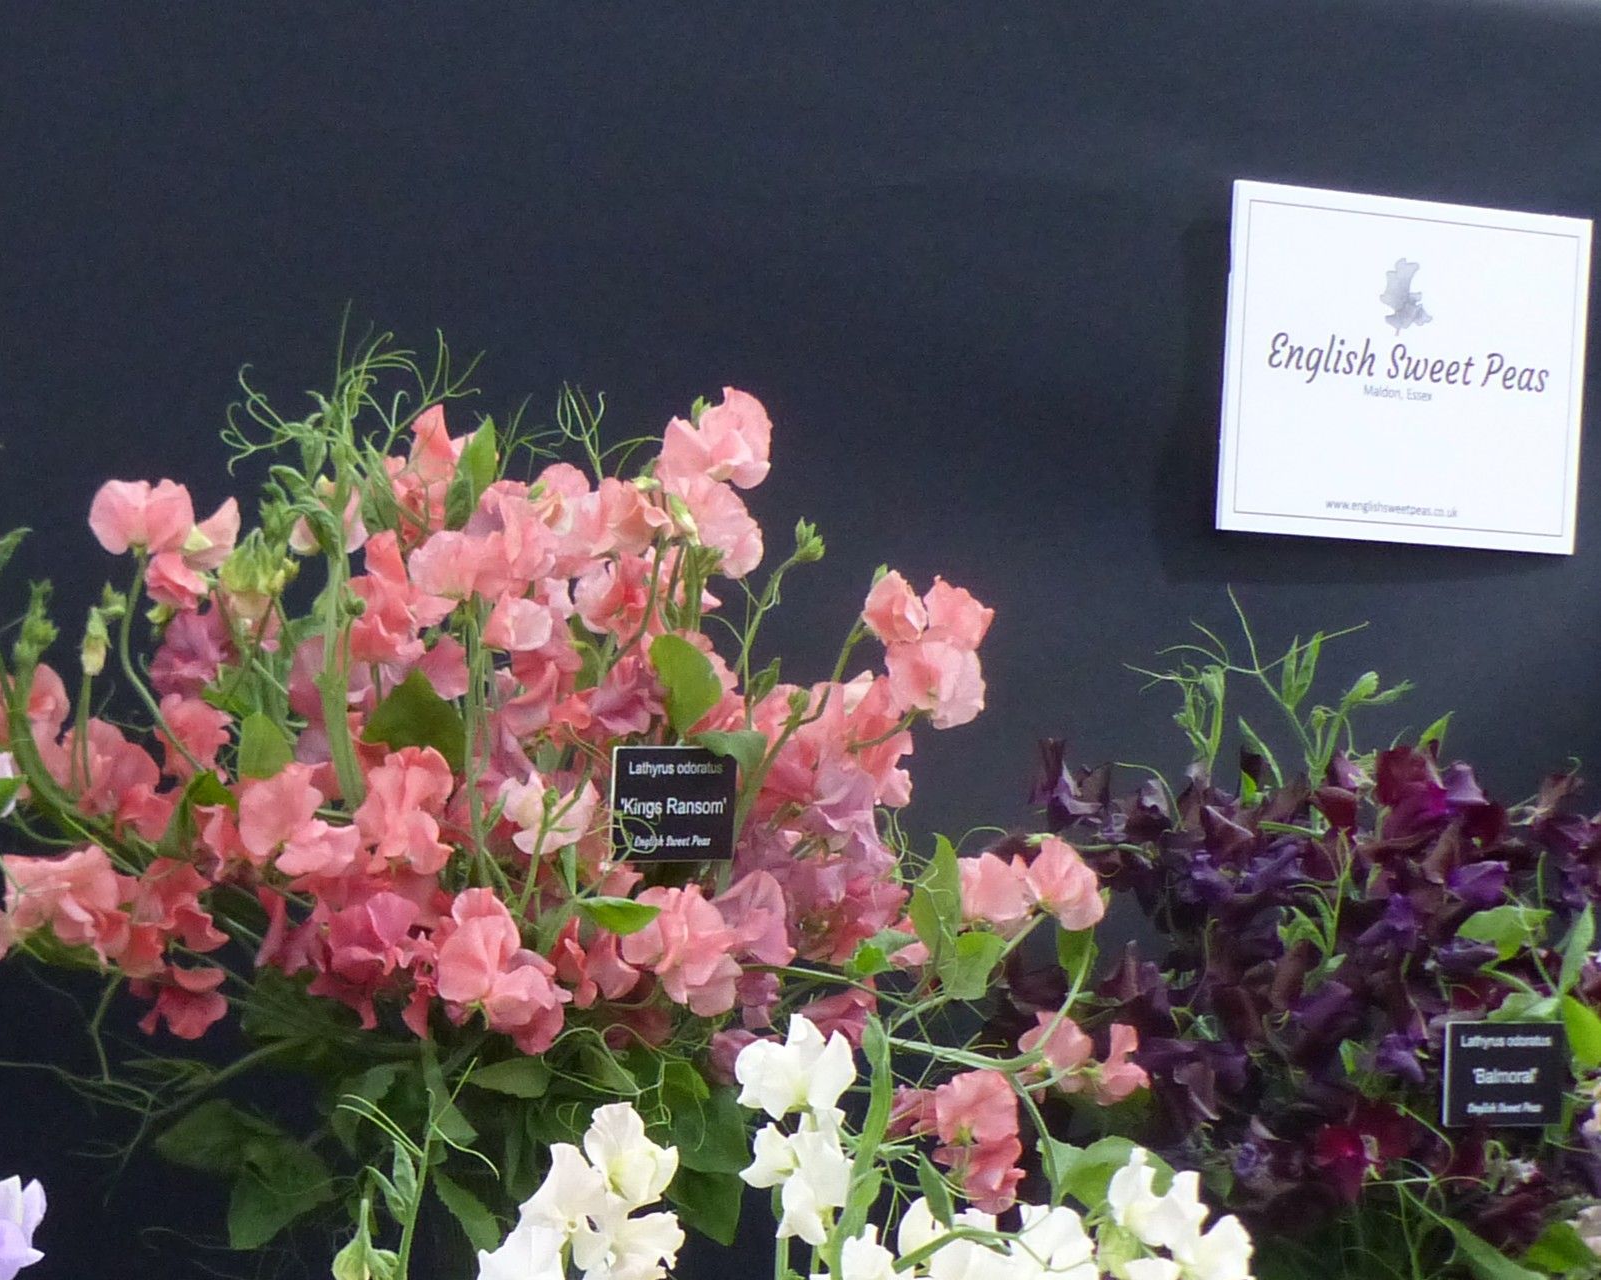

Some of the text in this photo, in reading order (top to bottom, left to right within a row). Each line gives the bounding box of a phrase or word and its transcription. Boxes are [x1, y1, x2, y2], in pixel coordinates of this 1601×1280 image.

[1267, 332, 1550, 394] English Sweet Peas
[1363, 384, 1433, 402] Maldon, Essex
[1325, 499, 1458, 518] www.englishsweetpeas.co.uk
[628, 761, 723, 777] Lathyrus odoratus
[620, 797, 727, 819] 'Kings Ransom'
[1460, 1035, 1505, 1050] Lathyrus
[1472, 1067, 1538, 1085] 'Balmoral'
